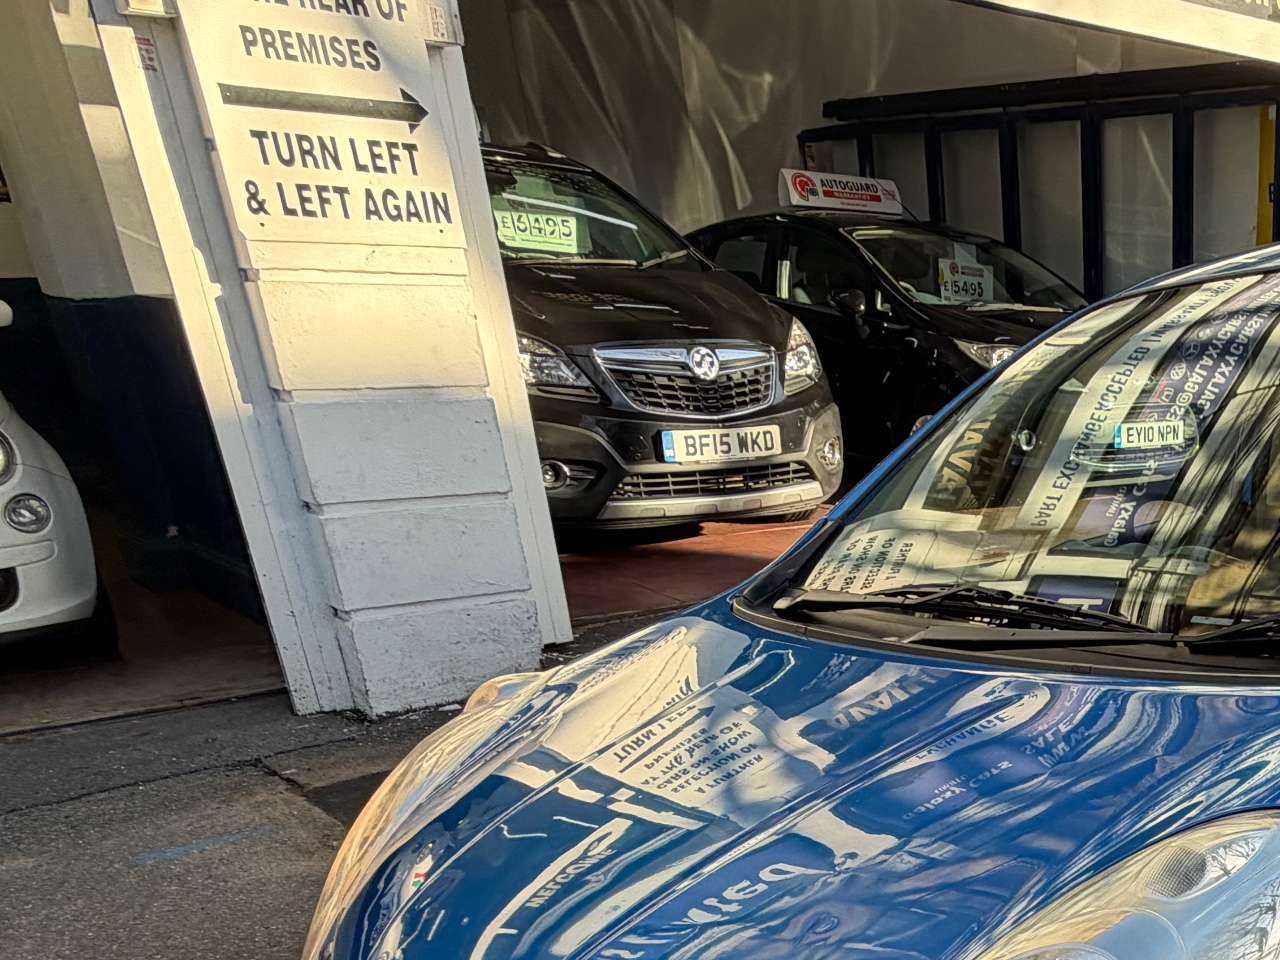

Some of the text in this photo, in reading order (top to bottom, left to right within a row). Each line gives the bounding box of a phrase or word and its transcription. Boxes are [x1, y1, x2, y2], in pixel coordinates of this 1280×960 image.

[239, 25, 382, 71] PREMISES
[250, 129, 419, 176] TURN LEFT
[820, 178, 879, 194] AUTOGUARD
[244, 179, 453, 224] & LEFT AGAIN
[944, 279, 984, 298] £5495
[684, 430, 775, 457] BF15 WKD
[1126, 424, 1180, 444] EY10 NPN
